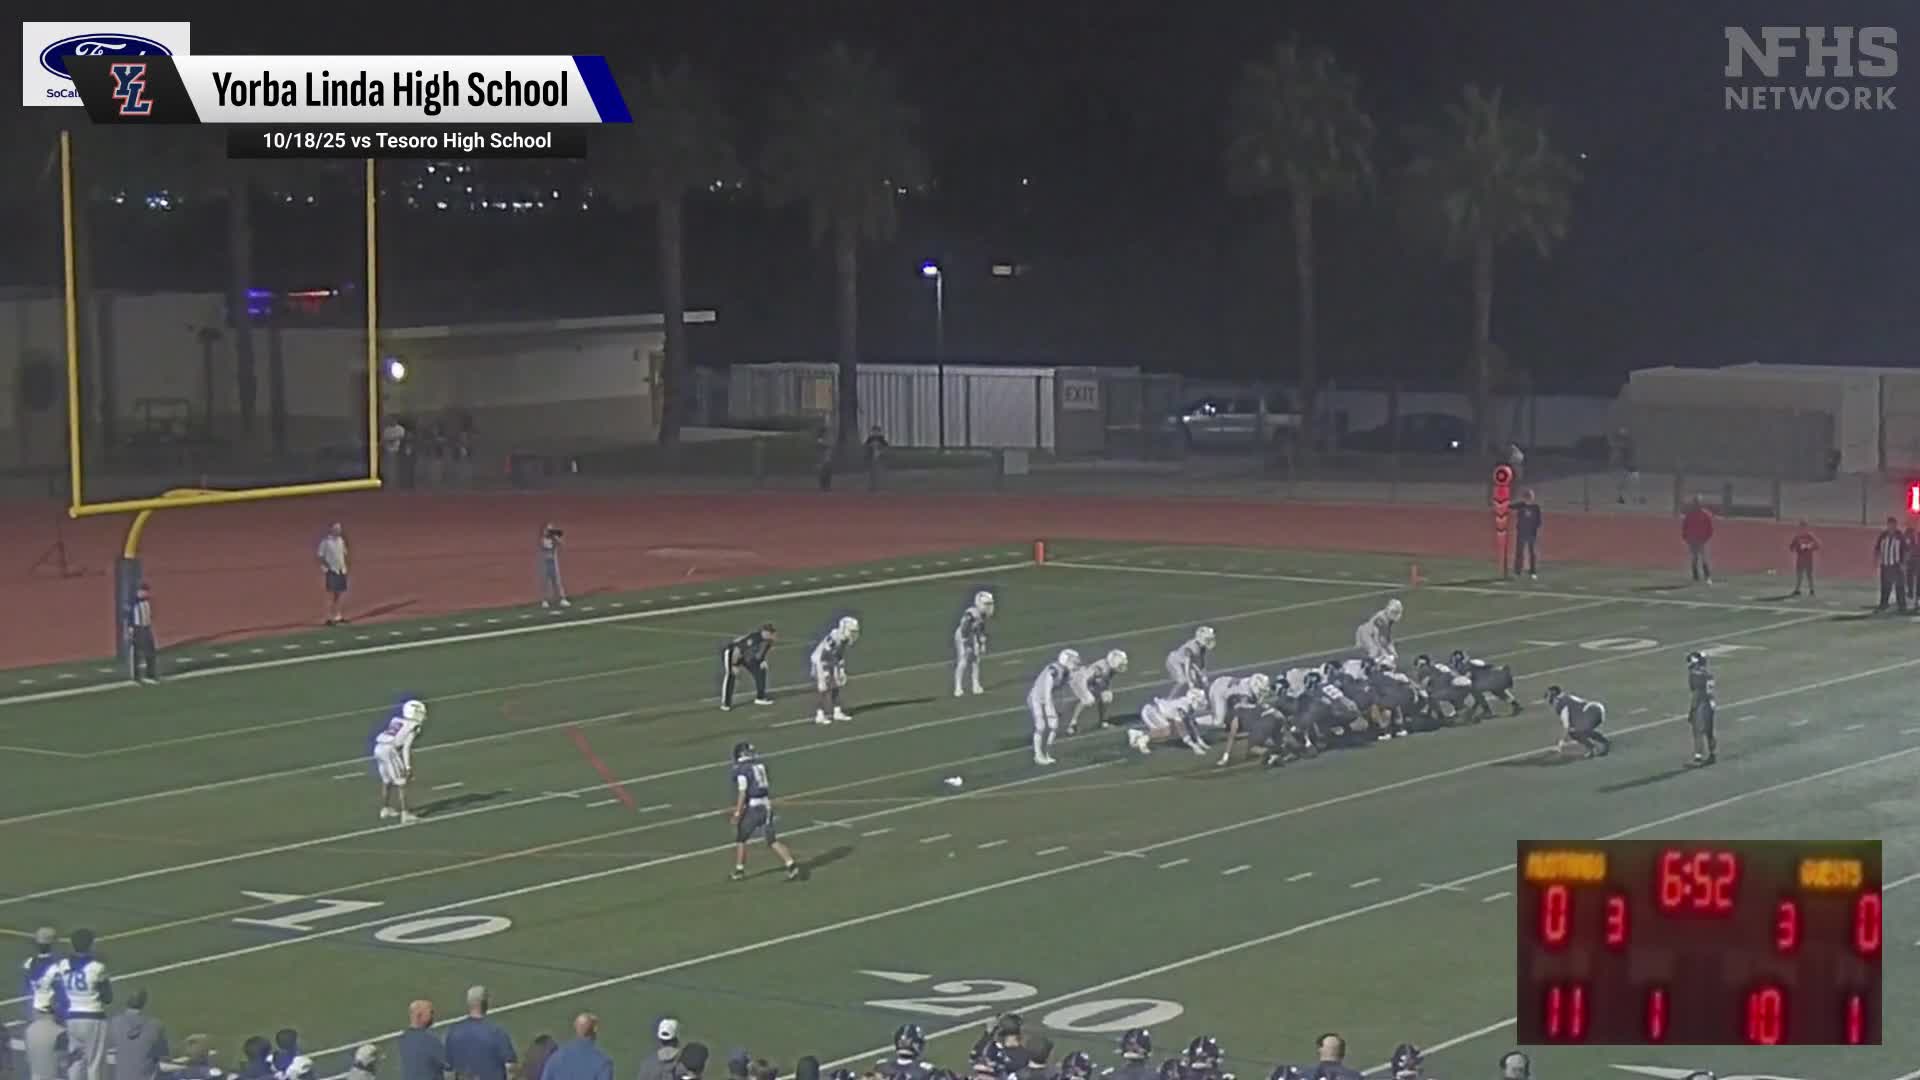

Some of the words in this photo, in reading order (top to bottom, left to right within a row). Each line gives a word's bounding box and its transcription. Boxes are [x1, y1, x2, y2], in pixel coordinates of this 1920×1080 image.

[1064, 384, 1097, 402] EXIT
[1661, 850, 1736, 907] 6:52
[1545, 885, 1567, 941] 0
[1606, 897, 1625, 944] 3
[1777, 902, 1796, 949] 3
[1857, 893, 1879, 950] 0
[1550, 986, 1582, 1037] 11
[1749, 989, 1780, 1044] 10
